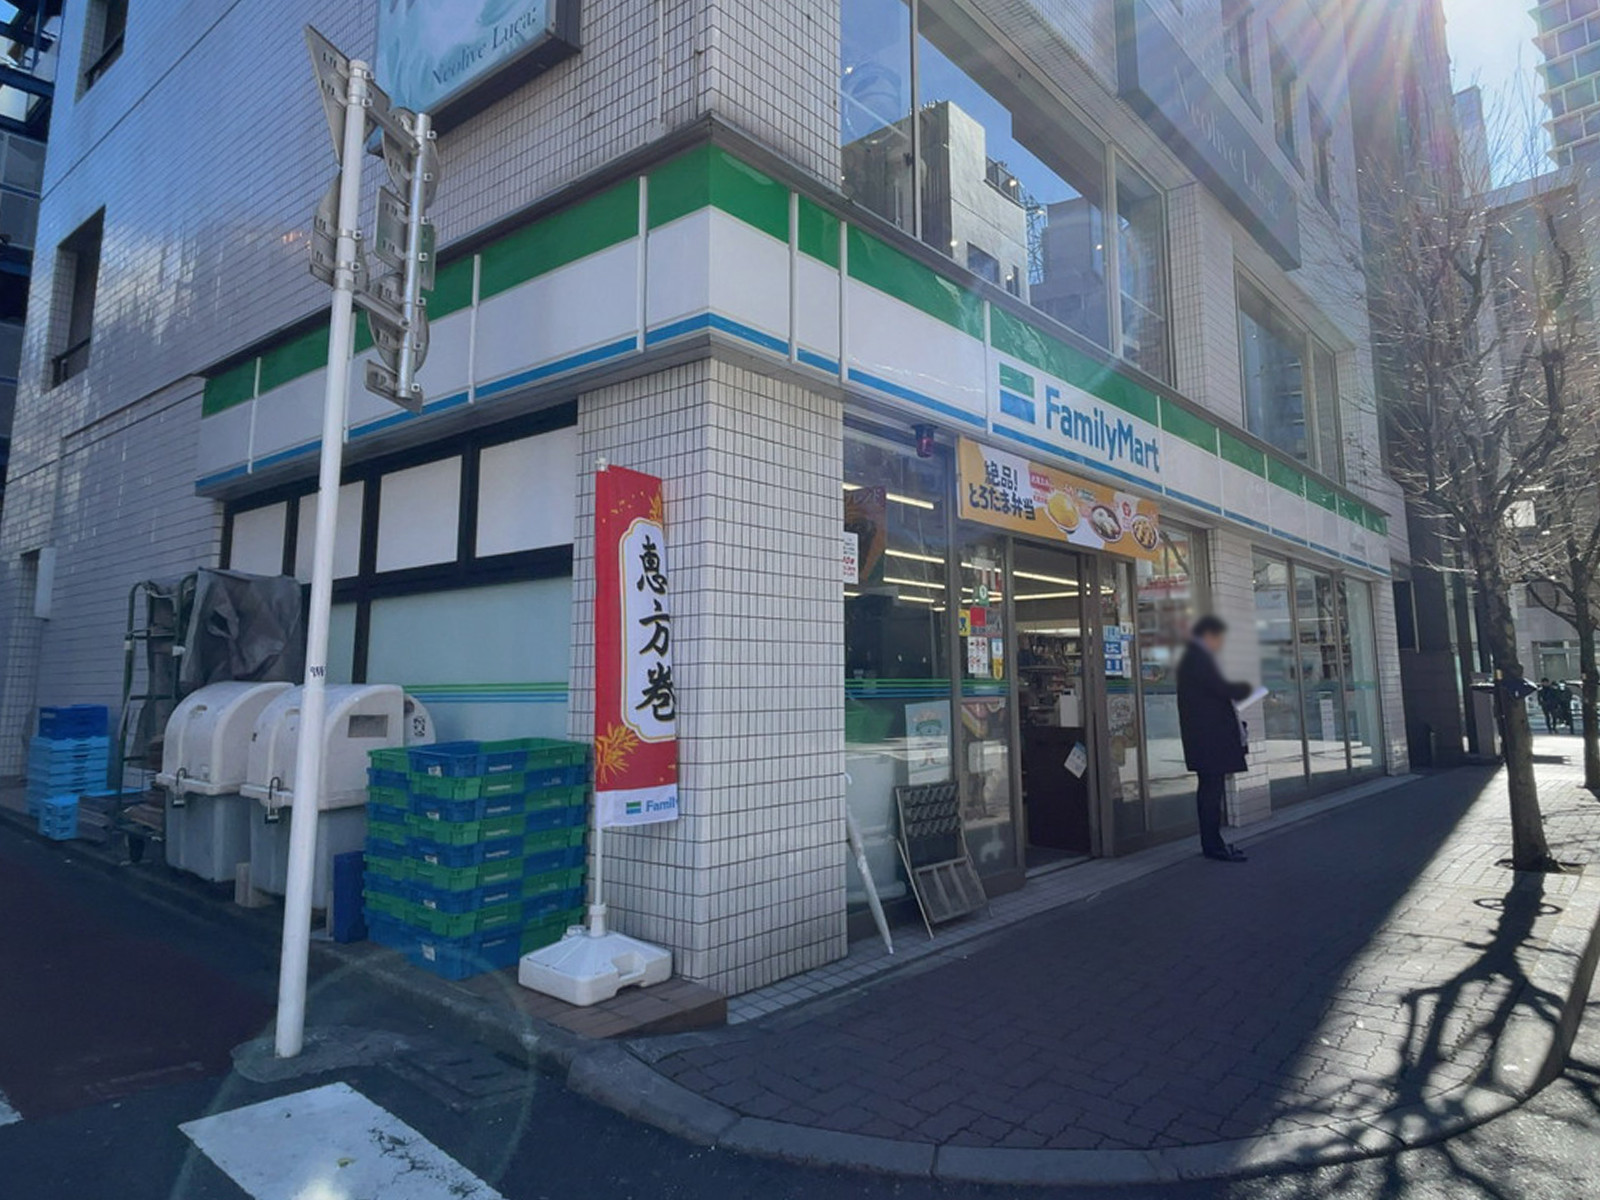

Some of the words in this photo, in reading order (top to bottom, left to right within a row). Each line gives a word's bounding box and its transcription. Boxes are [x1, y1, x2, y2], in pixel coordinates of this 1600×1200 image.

[1045, 384, 1160, 474] FamilyMart
[968, 482, 1036, 521] とろたま弁当
[635, 534, 676, 722] 恵方巻
